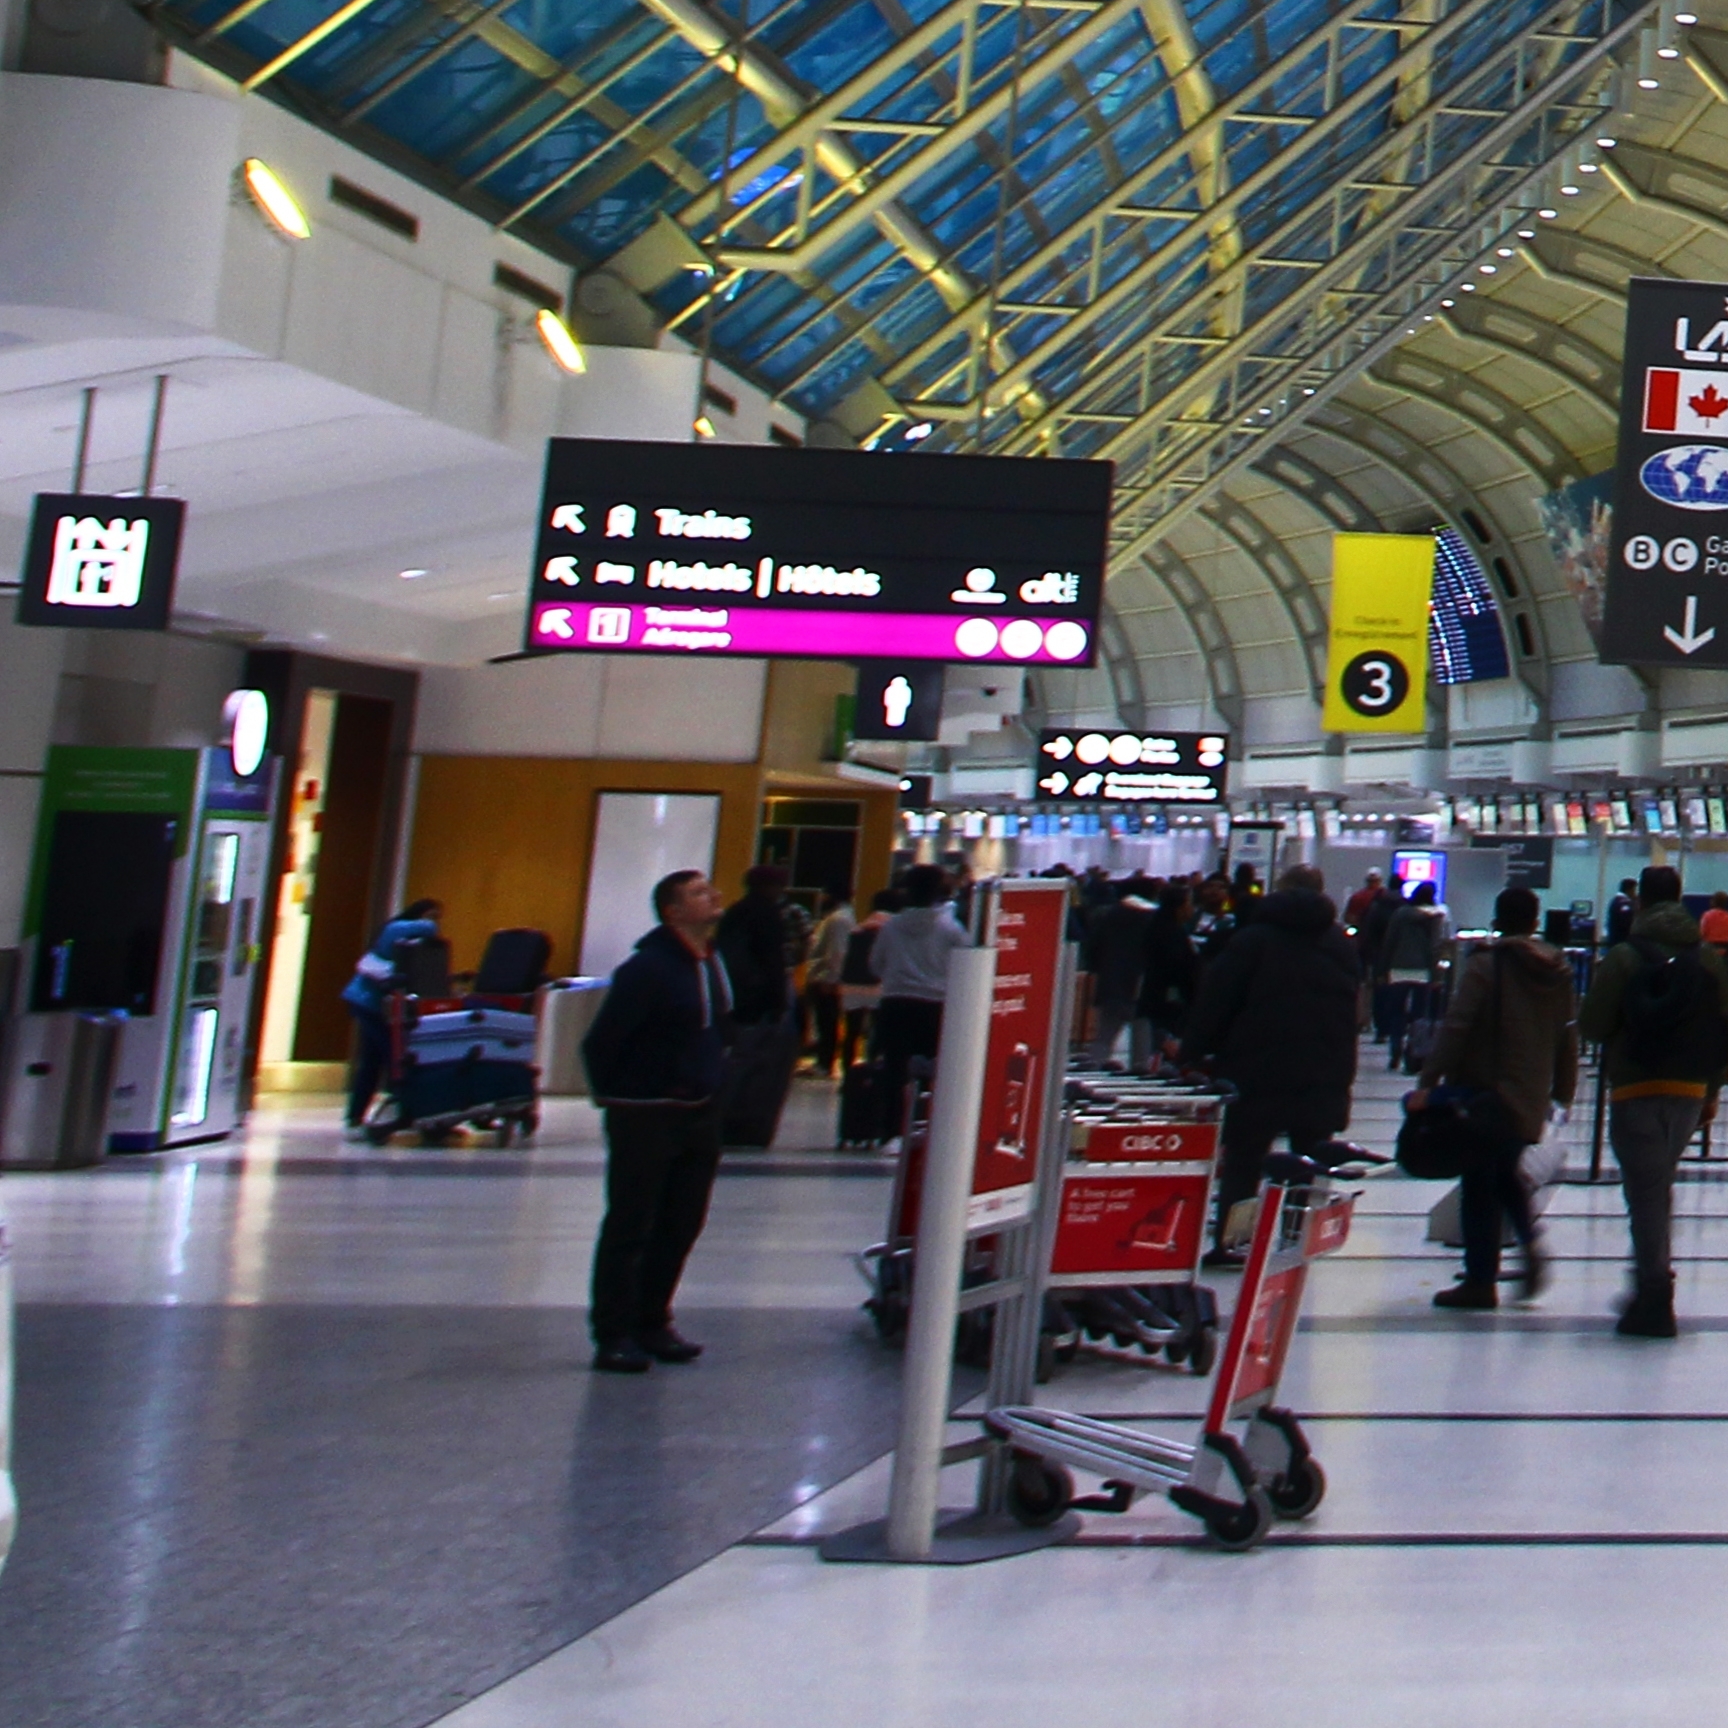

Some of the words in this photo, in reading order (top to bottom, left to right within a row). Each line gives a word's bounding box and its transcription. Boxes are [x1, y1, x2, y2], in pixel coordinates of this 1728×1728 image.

[654, 507, 752, 540] Trains
[647, 559, 753, 593] Hotels
[1357, 660, 1393, 707] 3
[1121, 1134, 1162, 1153] CIBC
